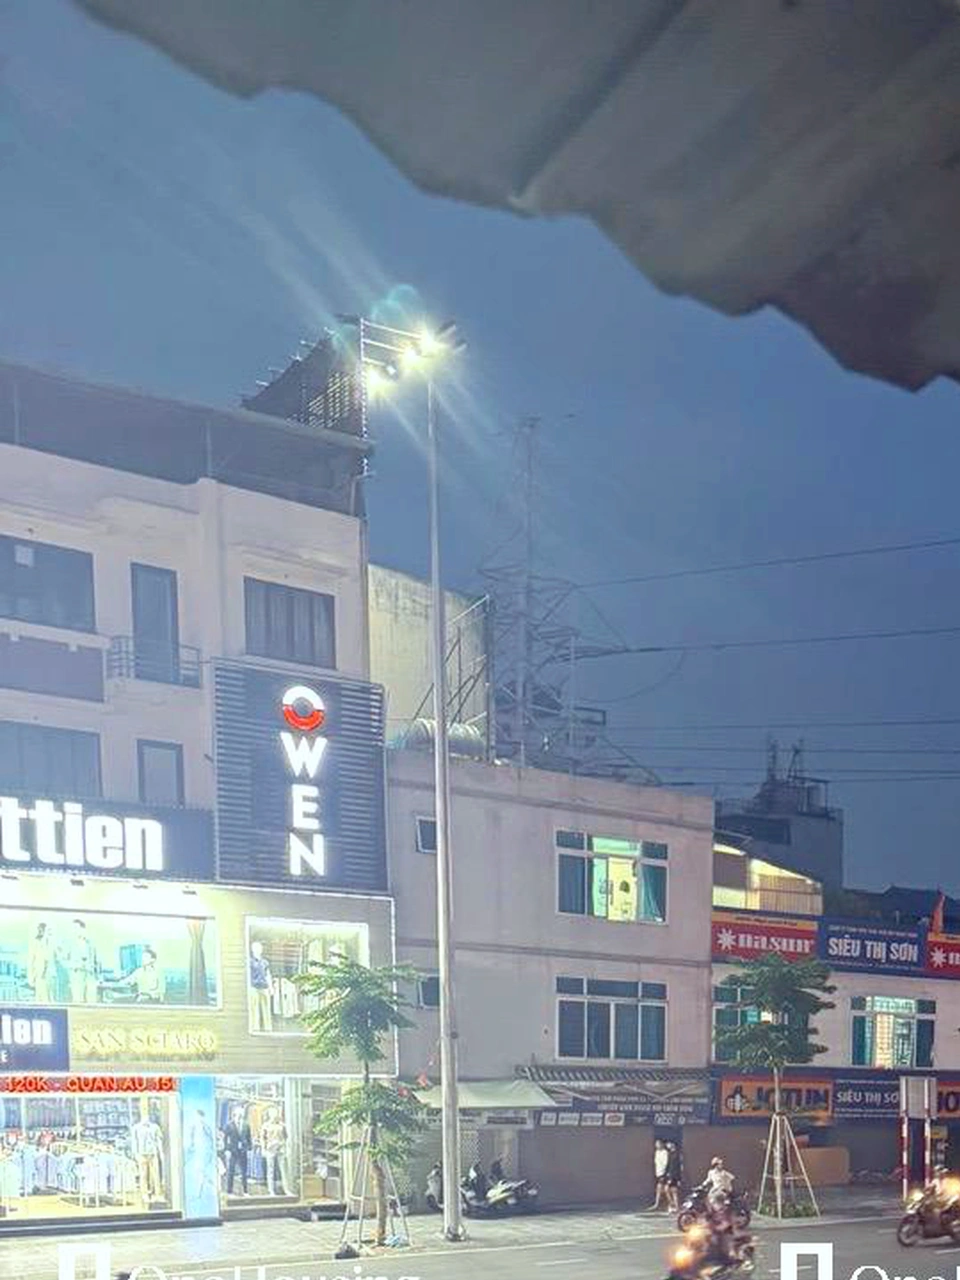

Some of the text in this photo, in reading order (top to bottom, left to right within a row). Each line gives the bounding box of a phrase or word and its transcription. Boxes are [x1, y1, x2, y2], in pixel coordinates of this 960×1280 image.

[280, 685, 328, 876] OWEN
[828, 934, 861, 957] SIÊU
[865, 940, 887, 962] THỊ
